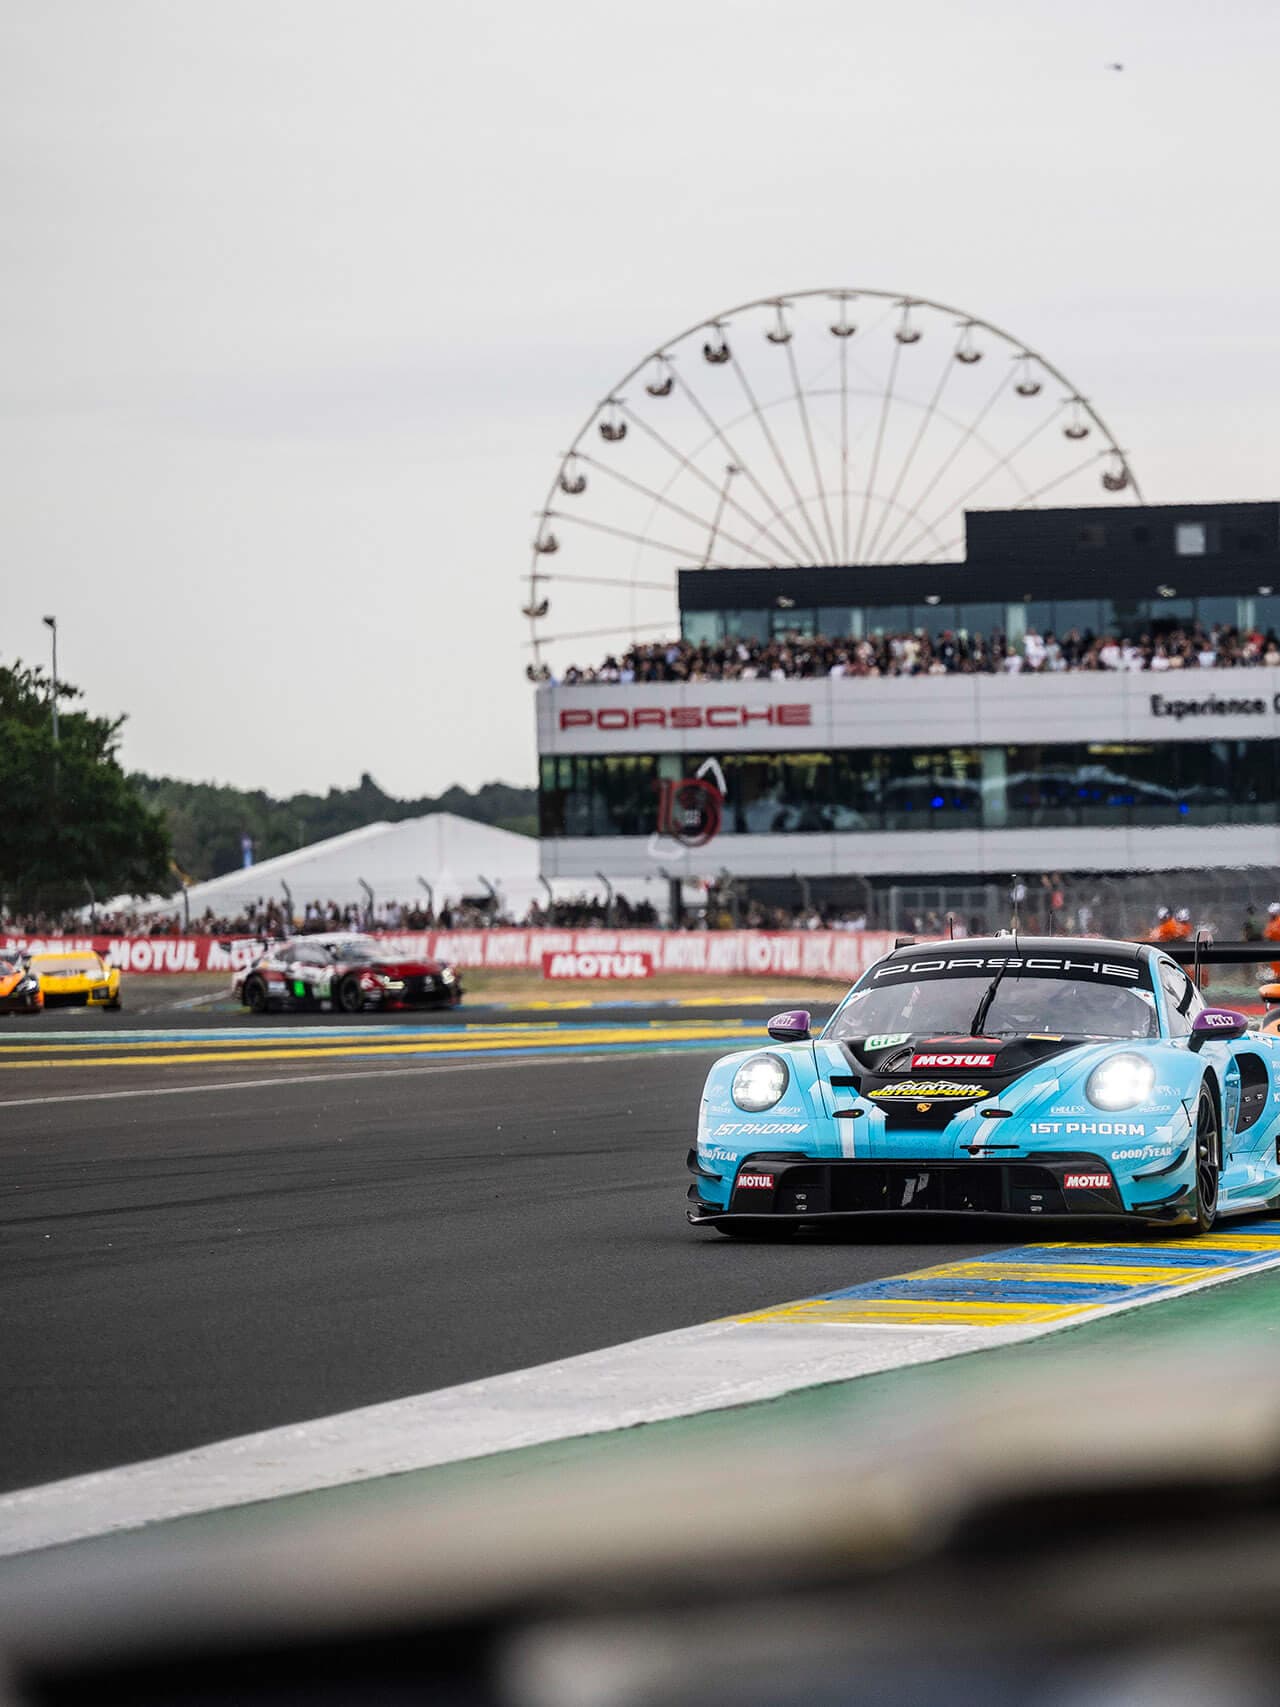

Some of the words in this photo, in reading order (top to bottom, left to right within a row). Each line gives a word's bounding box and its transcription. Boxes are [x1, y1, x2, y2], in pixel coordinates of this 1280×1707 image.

[1150, 693, 1266, 720] Experience
[560, 704, 812, 730] PORSCHE
[106, 940, 199, 970] MOTUL
[550, 954, 648, 977] MOTUL
[873, 957, 1139, 980] PORSCHE
[915, 1055, 992, 1066] MOTUL
[881, 1083, 982, 1092] MOUNTAIN
[714, 1124, 739, 1136] 1ST
[738, 1124, 809, 1136] PHORM
[1030, 1123, 1062, 1134] 1ST
[1066, 1124, 1145, 1136] PHORM
[738, 1176, 772, 1187] MOTUL
[1066, 1176, 1110, 1187] MOTUL
